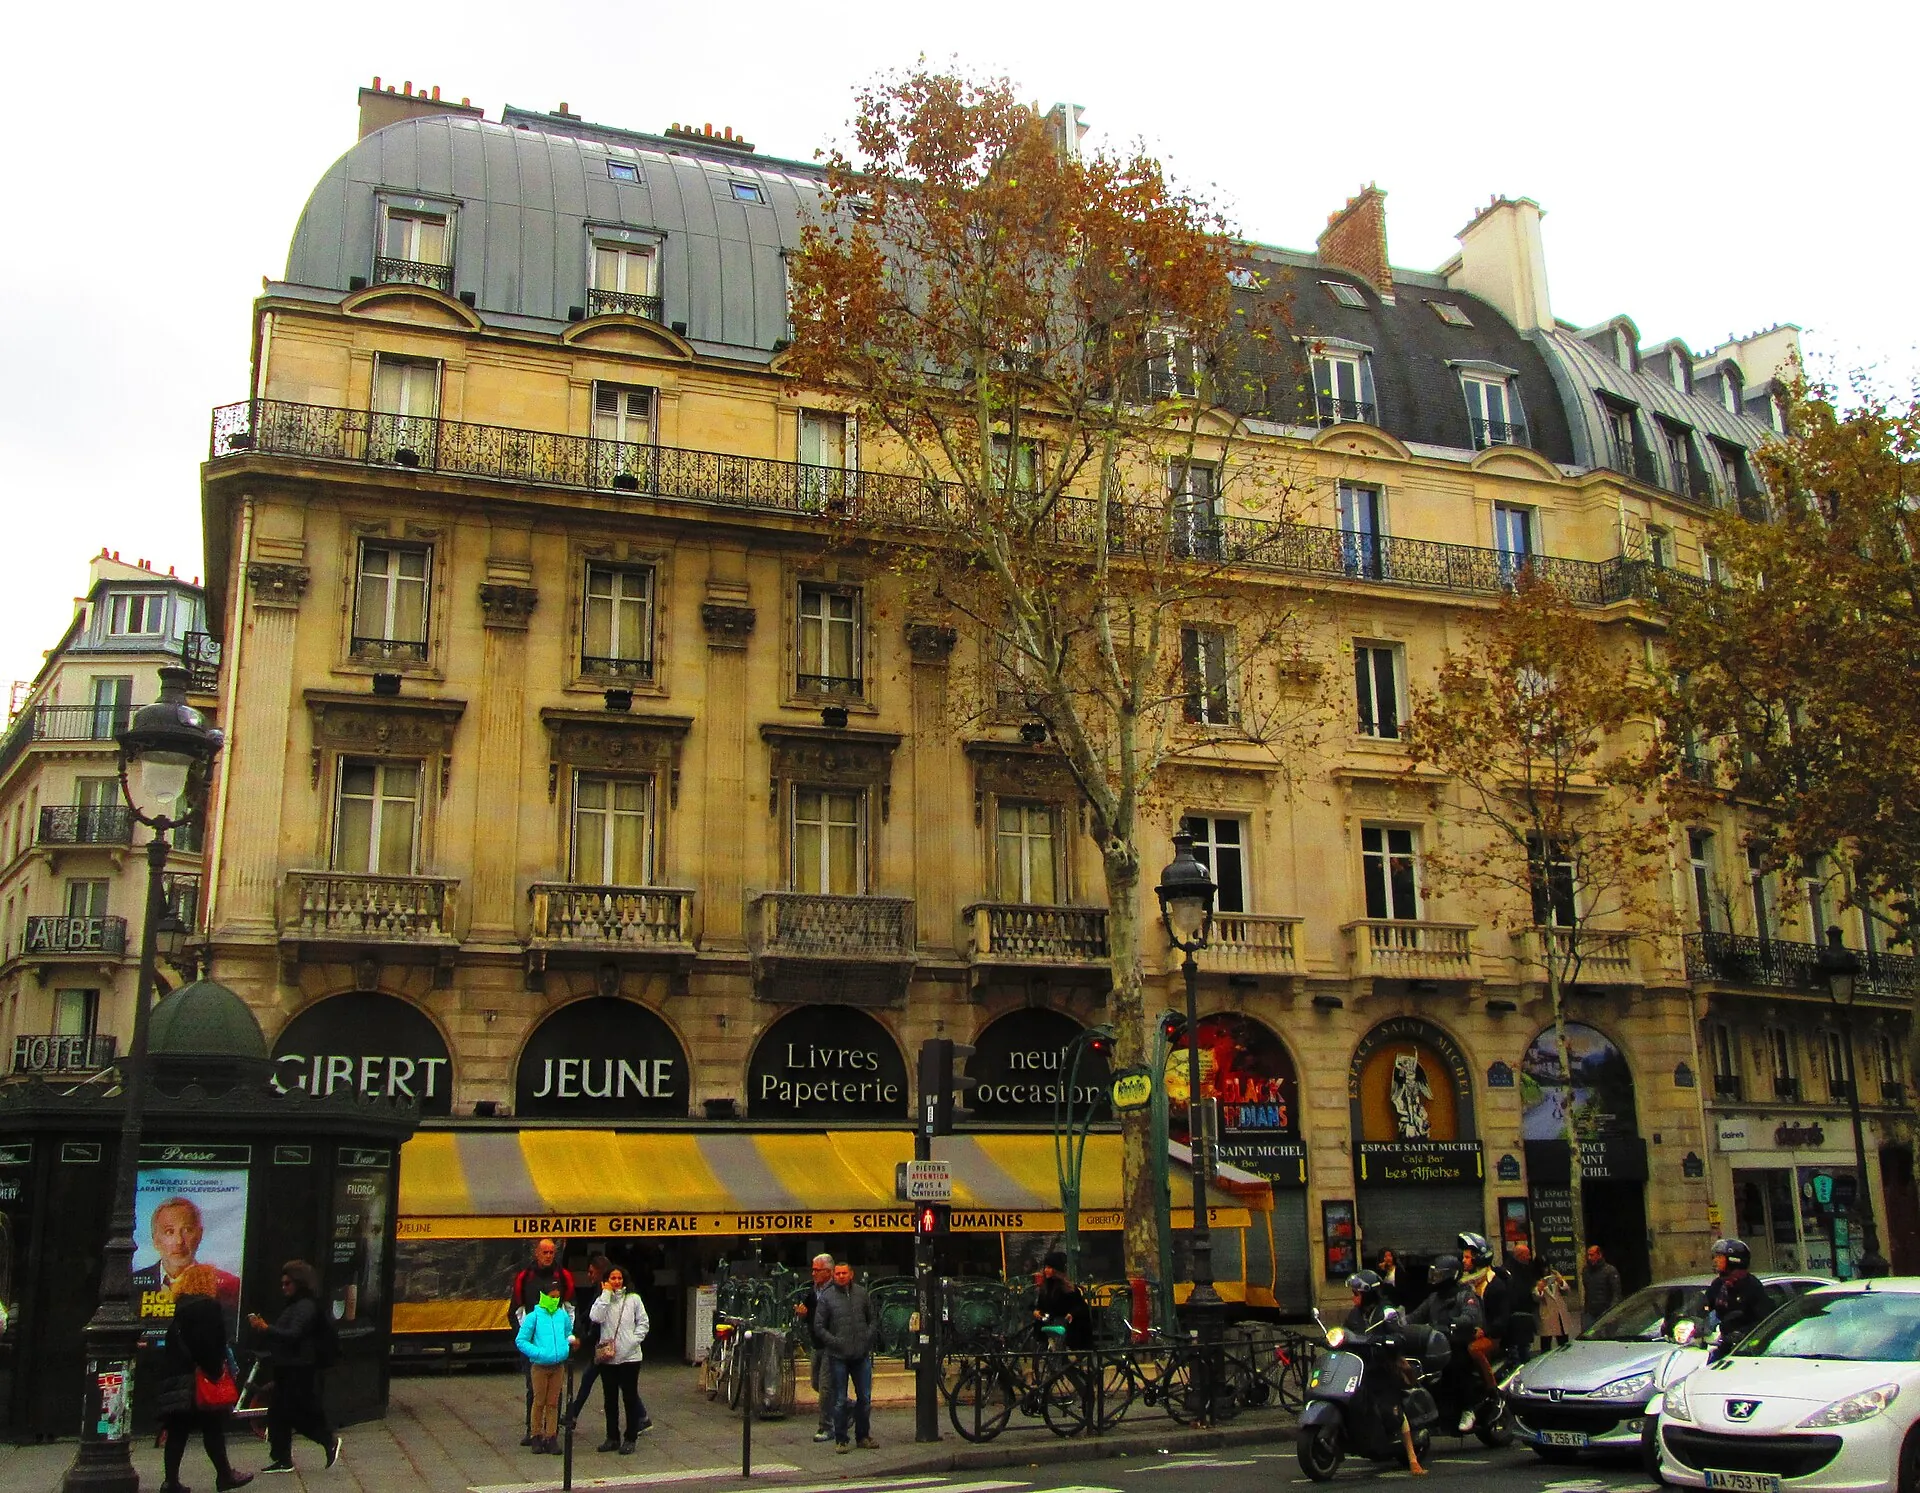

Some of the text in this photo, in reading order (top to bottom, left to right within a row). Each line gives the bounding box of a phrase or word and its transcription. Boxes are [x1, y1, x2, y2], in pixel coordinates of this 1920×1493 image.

[12, 1038, 100, 1069] HOTEL
[787, 1043, 878, 1070] Livres
[1349, 1022, 1470, 1100] ESPACE SAINT MICHEL
[270, 1054, 448, 1098] GIBERT
[533, 1059, 675, 1098] JEUNE
[761, 1075, 898, 1106] Papeterie
[1721, 1131, 1744, 1139] claire's
[161, 1146, 216, 1160] Presse
[1219, 1146, 1304, 1157] SAINT MICHEL
[1361, 1143, 1481, 1152] ESPACE SAINT MICHEL
[1580, 1142, 1607, 1153] PACE
[1427, 1155, 1445, 1163] Bar
[1581, 1155, 1604, 1165] AINT
[1582, 1167, 1611, 1177] CHEL
[347, 1184, 376, 1195] FILORGA
[737, 1215, 813, 1229] HISTOIRE
[950, 1212, 1024, 1228] UMAINES
[1210, 1210, 1217, 1221] 5
[1543, 1216, 1571, 1224] CINEM
[513, 1217, 698, 1233] LIBRAIRIE GENERALE
[141, 1304, 176, 1318] PRE
